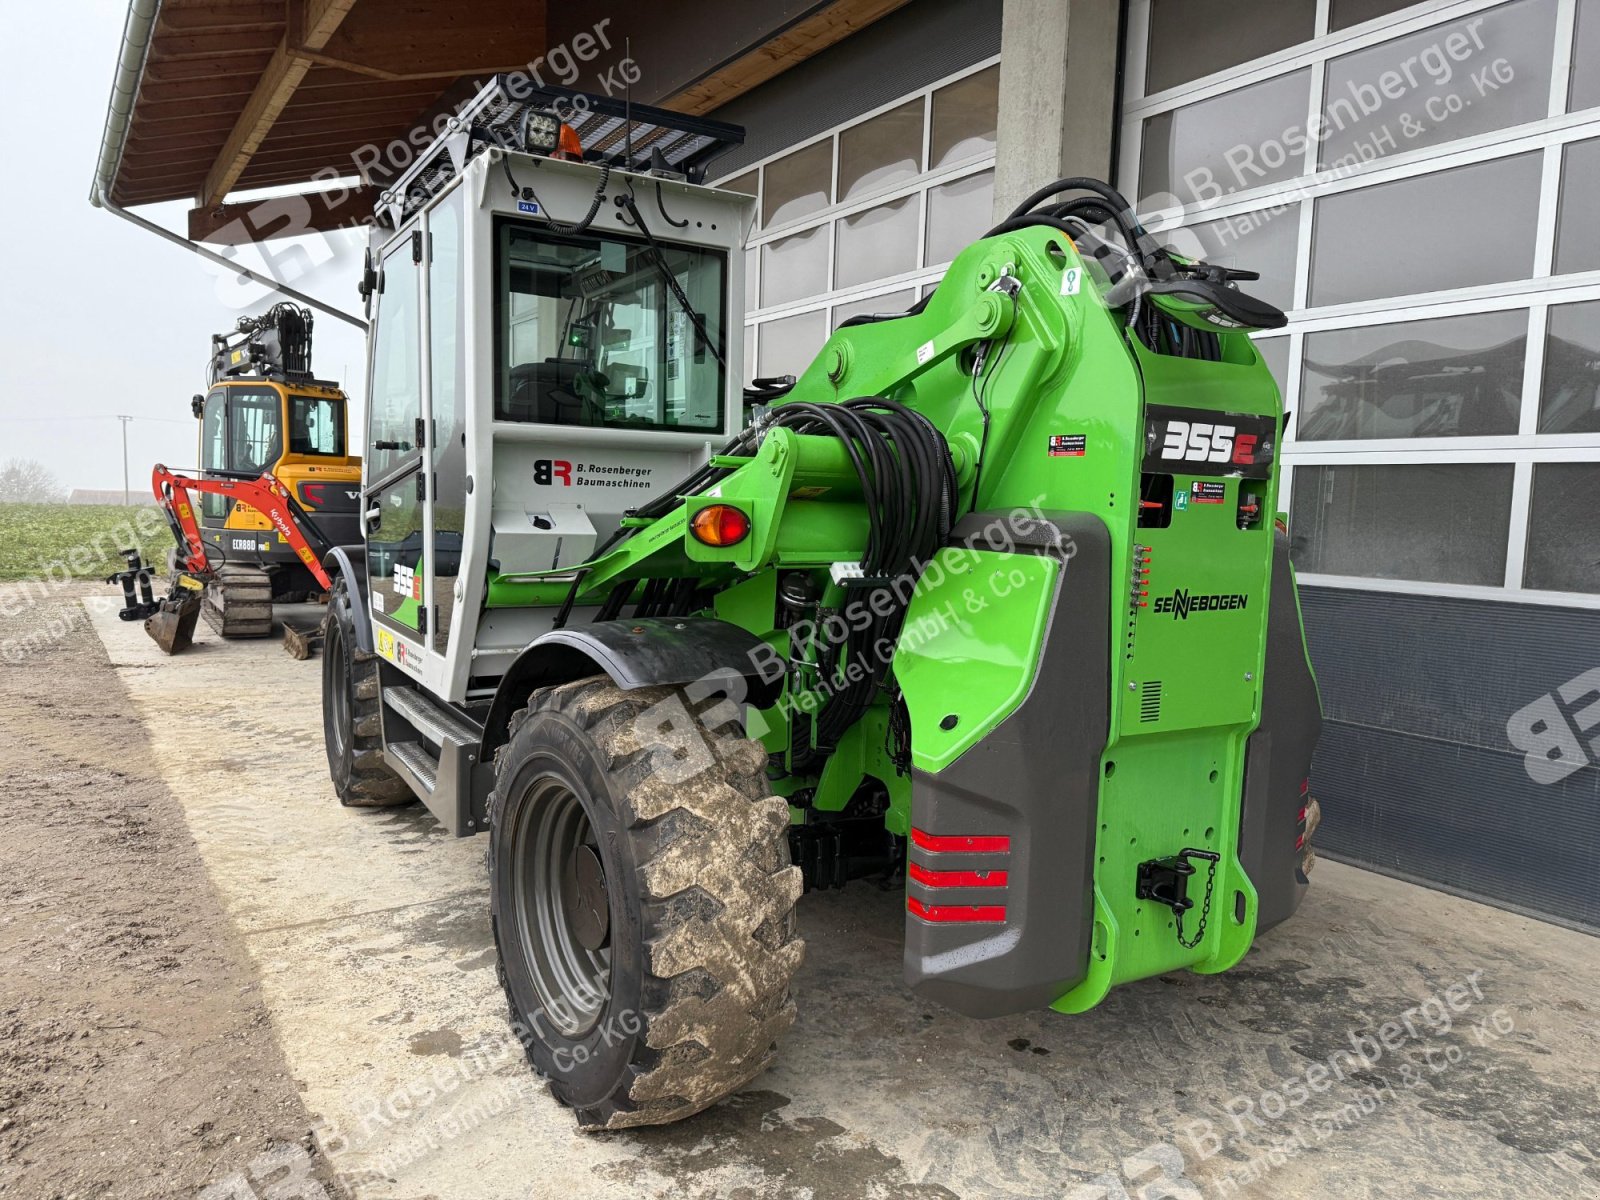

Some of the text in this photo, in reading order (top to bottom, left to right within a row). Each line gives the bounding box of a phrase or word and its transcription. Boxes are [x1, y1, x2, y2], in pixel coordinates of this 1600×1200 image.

[1161, 420, 1258, 464] 355E
[576, 477, 651, 488] Baumaschinen
[588, 464, 652, 477] Rosenberger
[270, 508, 291, 537] Kubota
[393, 563, 421, 601] 355E
